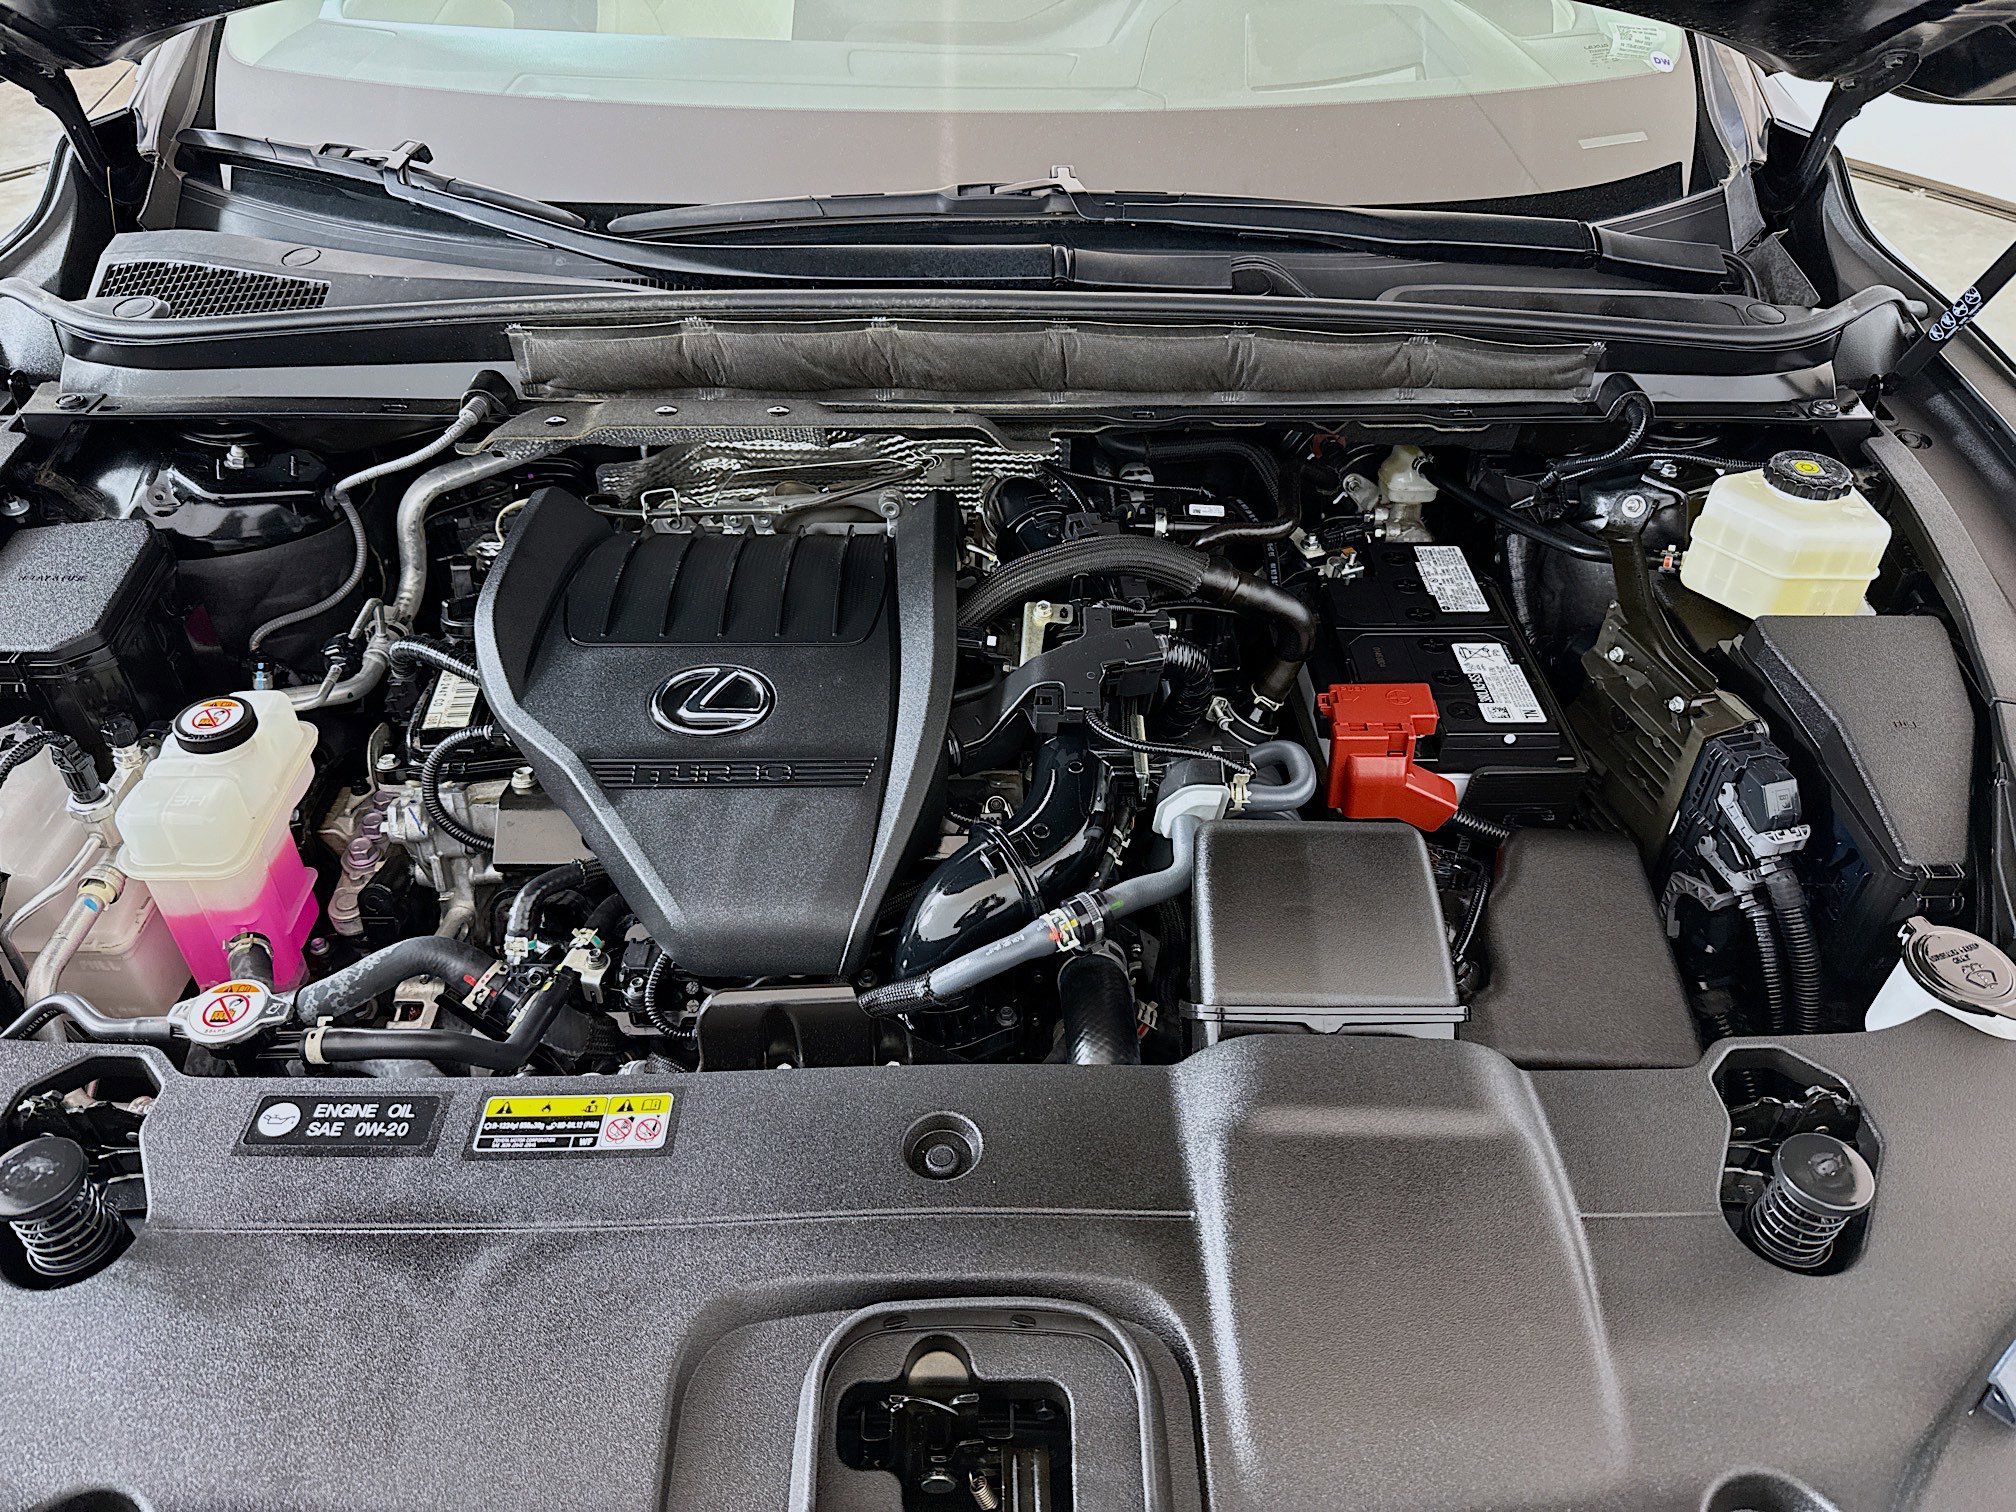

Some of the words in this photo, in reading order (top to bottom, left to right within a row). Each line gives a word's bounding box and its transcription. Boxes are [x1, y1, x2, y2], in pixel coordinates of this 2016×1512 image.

[1653, 57, 1670, 66] DW
[1522, 709, 1539, 719] TN
[637, 764, 792, 782] TURBO
[313, 1103, 379, 1118] ENGINE
[387, 1103, 415, 1119] OIL
[306, 1122, 345, 1137] SAE
[354, 1122, 409, 1137] 0W-20
